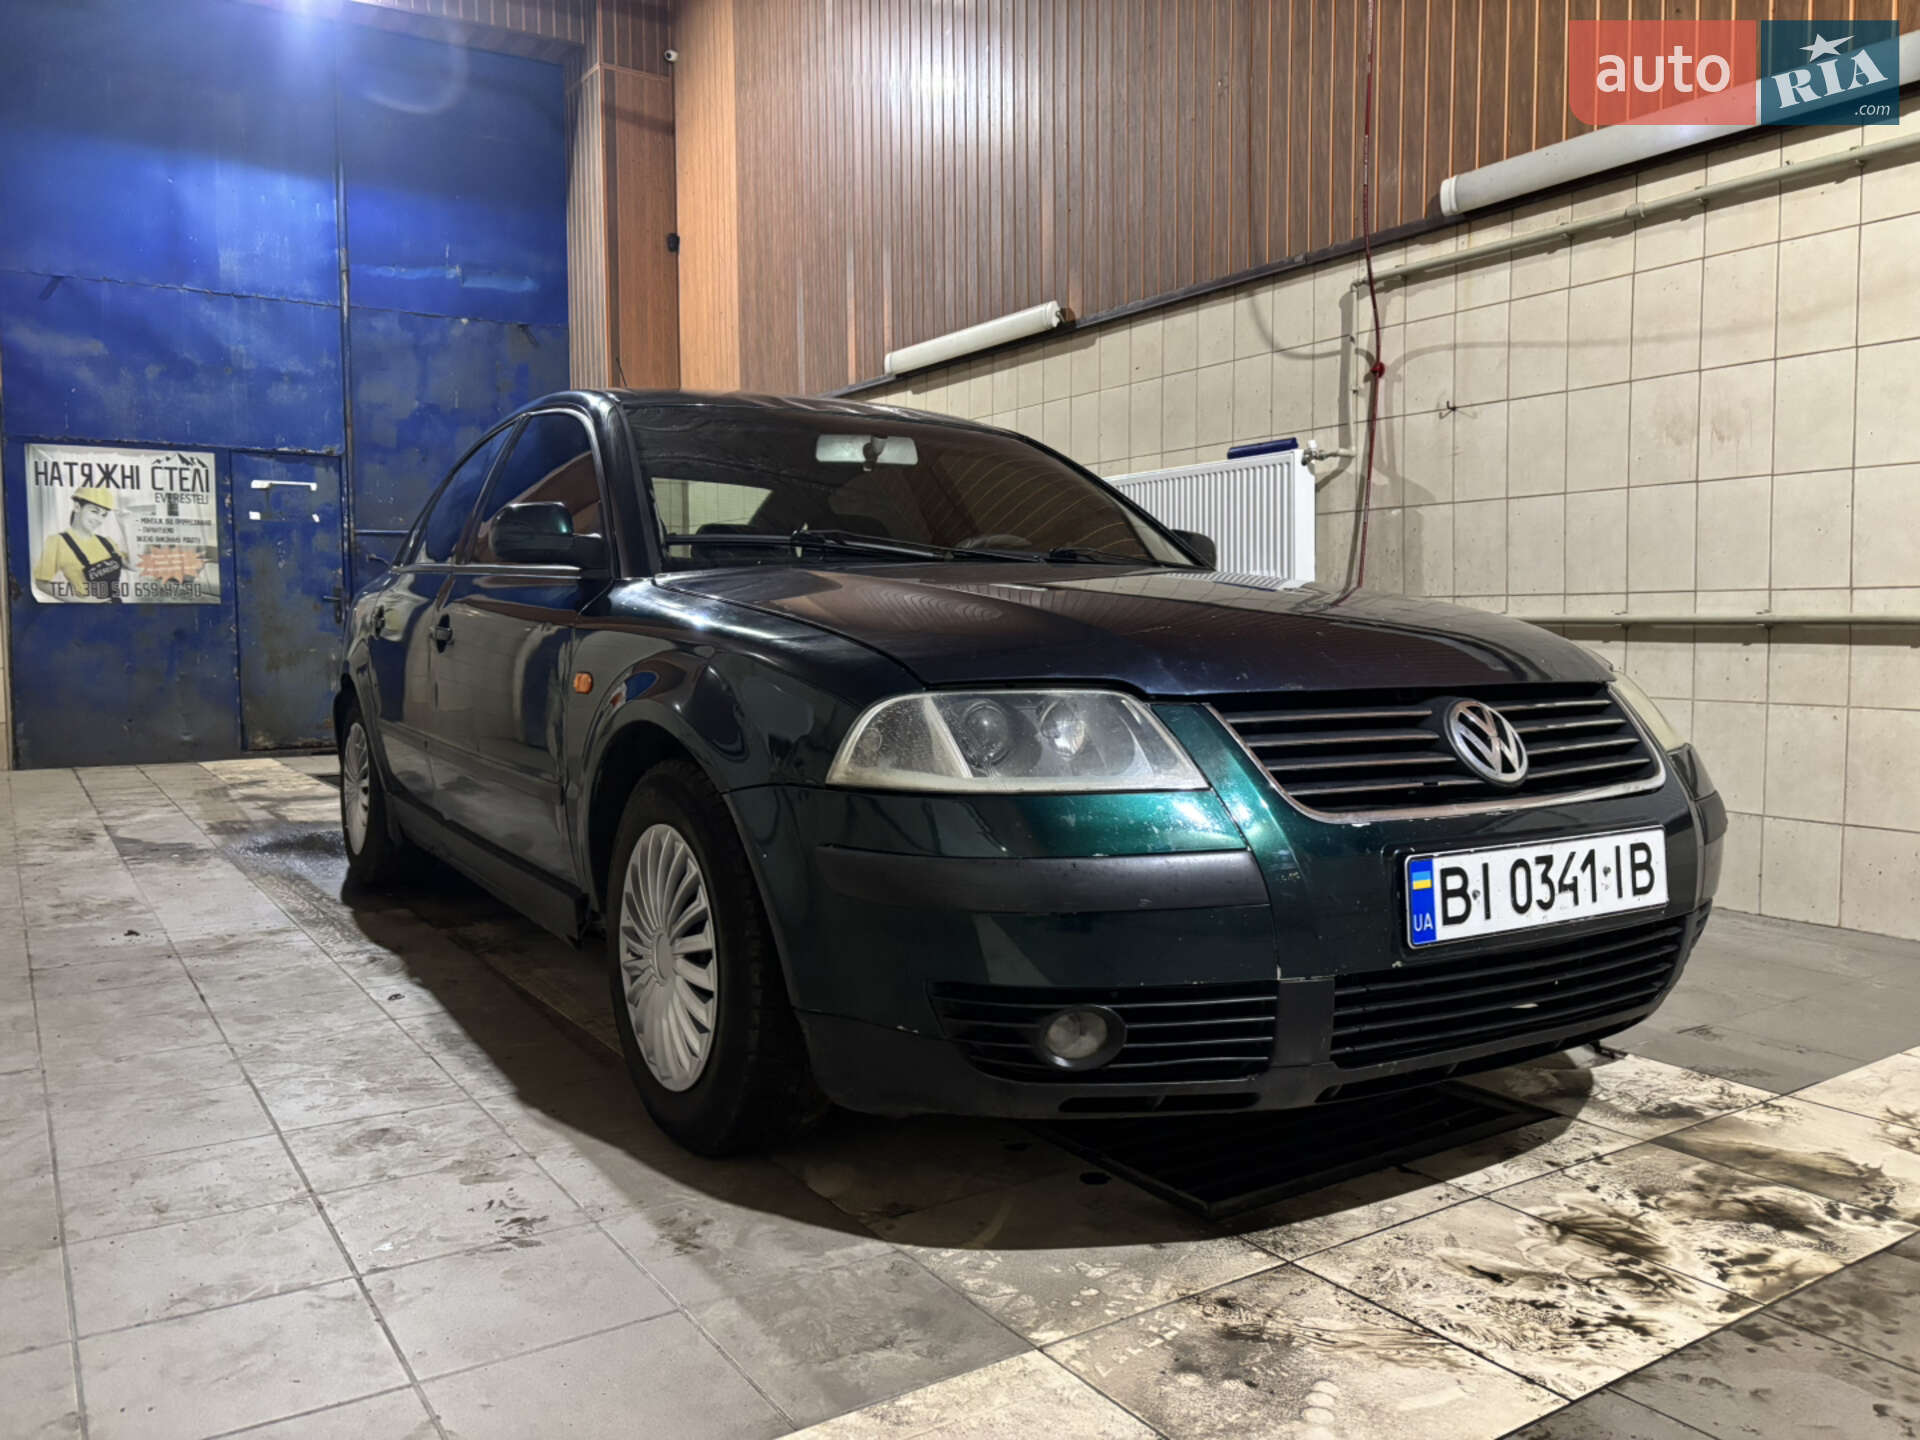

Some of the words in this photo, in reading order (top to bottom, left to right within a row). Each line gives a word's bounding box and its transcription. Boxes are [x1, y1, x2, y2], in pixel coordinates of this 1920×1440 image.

[34, 460, 141, 490] НАТЯЖНІ
[151, 466, 210, 493] СТЕЛІ
[112, 582, 129, 598] 50
[1440, 863, 1491, 926] BI
[1510, 849, 1598, 915] 0341
[1615, 842, 1655, 900] IB
[1413, 912, 1433, 932] UA
